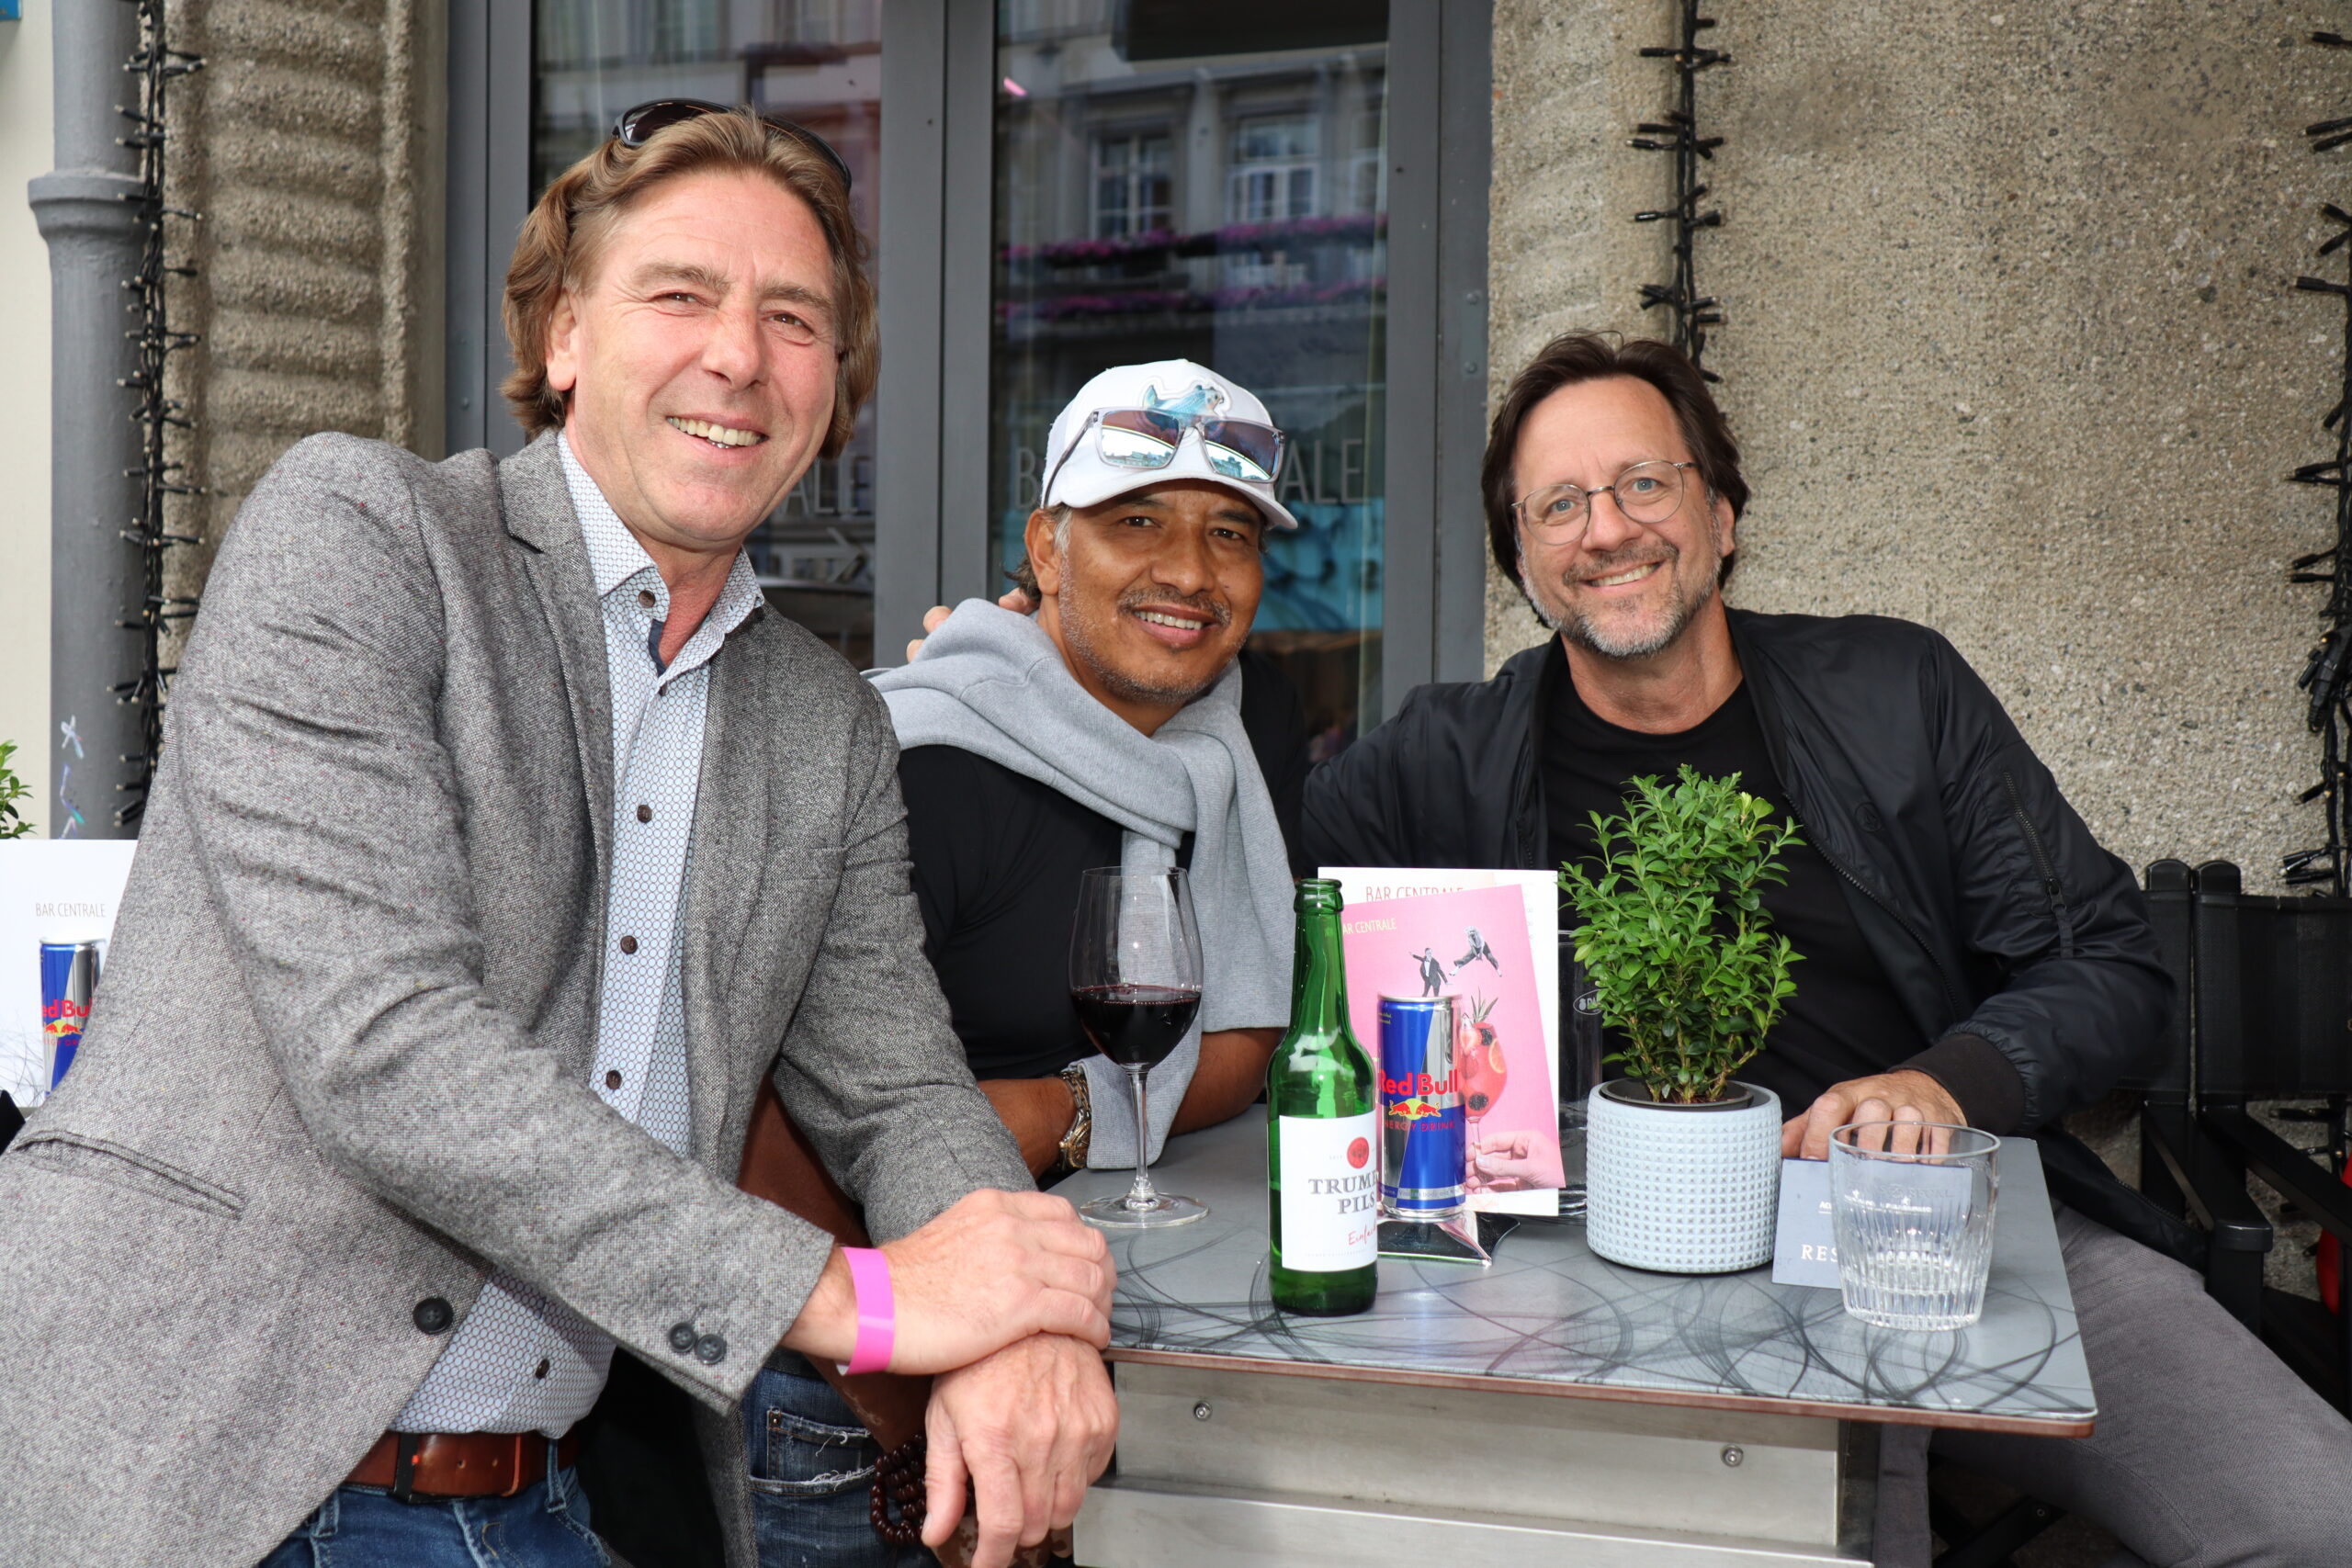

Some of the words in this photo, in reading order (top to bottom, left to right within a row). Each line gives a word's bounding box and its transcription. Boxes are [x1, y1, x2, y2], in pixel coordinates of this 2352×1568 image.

[1366, 886, 1391, 902] BAR
[35, 902, 55, 917] BAR
[57, 902, 106, 918] CENTRALE
[1342, 922, 1354, 935] AR
[1354, 918, 1397, 934] CENTRALE
[41, 998, 59, 1017] ed
[61, 997, 93, 1018] Bu
[1416, 1068, 1458, 1096] Bull
[1384, 1119, 1416, 1131] NERGY
[1420, 1120, 1454, 1132] DRINK
[1337, 1191, 1375, 1214] PILS
